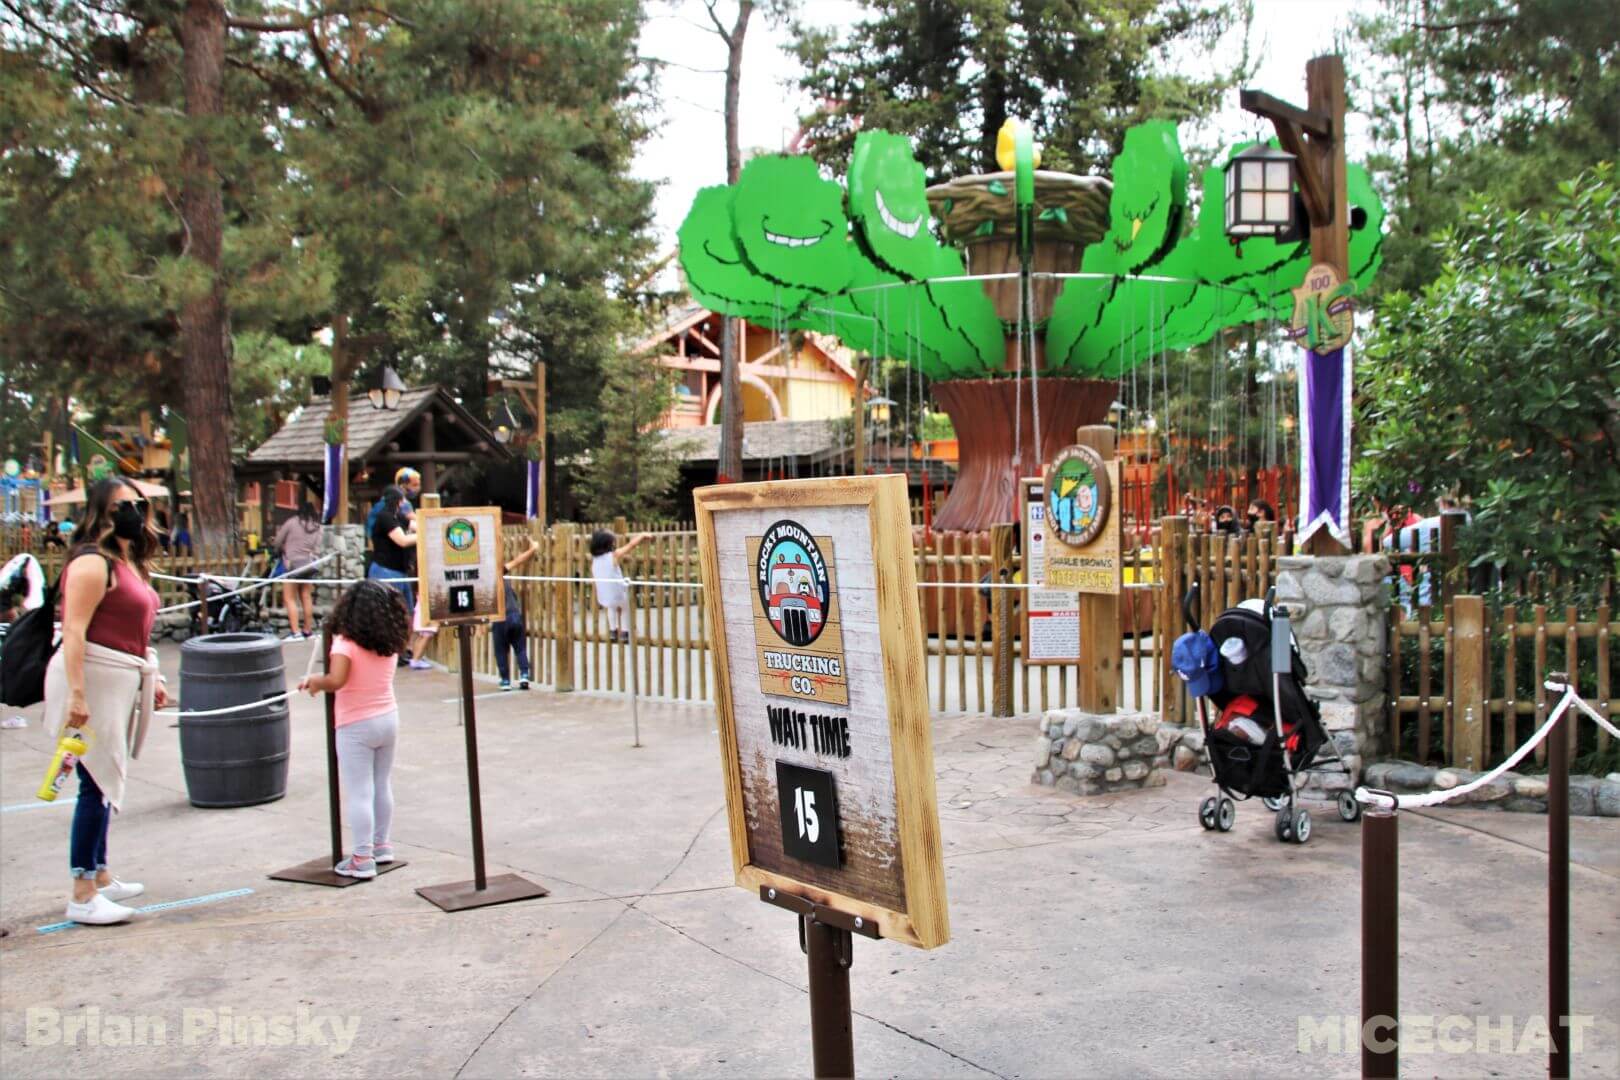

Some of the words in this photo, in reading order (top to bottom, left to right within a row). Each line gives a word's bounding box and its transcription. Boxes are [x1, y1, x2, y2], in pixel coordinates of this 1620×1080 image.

[1311, 275, 1330, 291] 100
[760, 531, 777, 581] ROCKY
[776, 525, 827, 582] MOUNTAIN
[444, 570, 462, 581] WAIT
[463, 568, 480, 580] TIME
[457, 591, 469, 607] 15
[764, 650, 841, 676] TRUCKING
[791, 675, 816, 695] CO.
[767, 704, 807, 751] WAIT
[809, 714, 851, 759] TIME
[794, 786, 820, 843] 15
